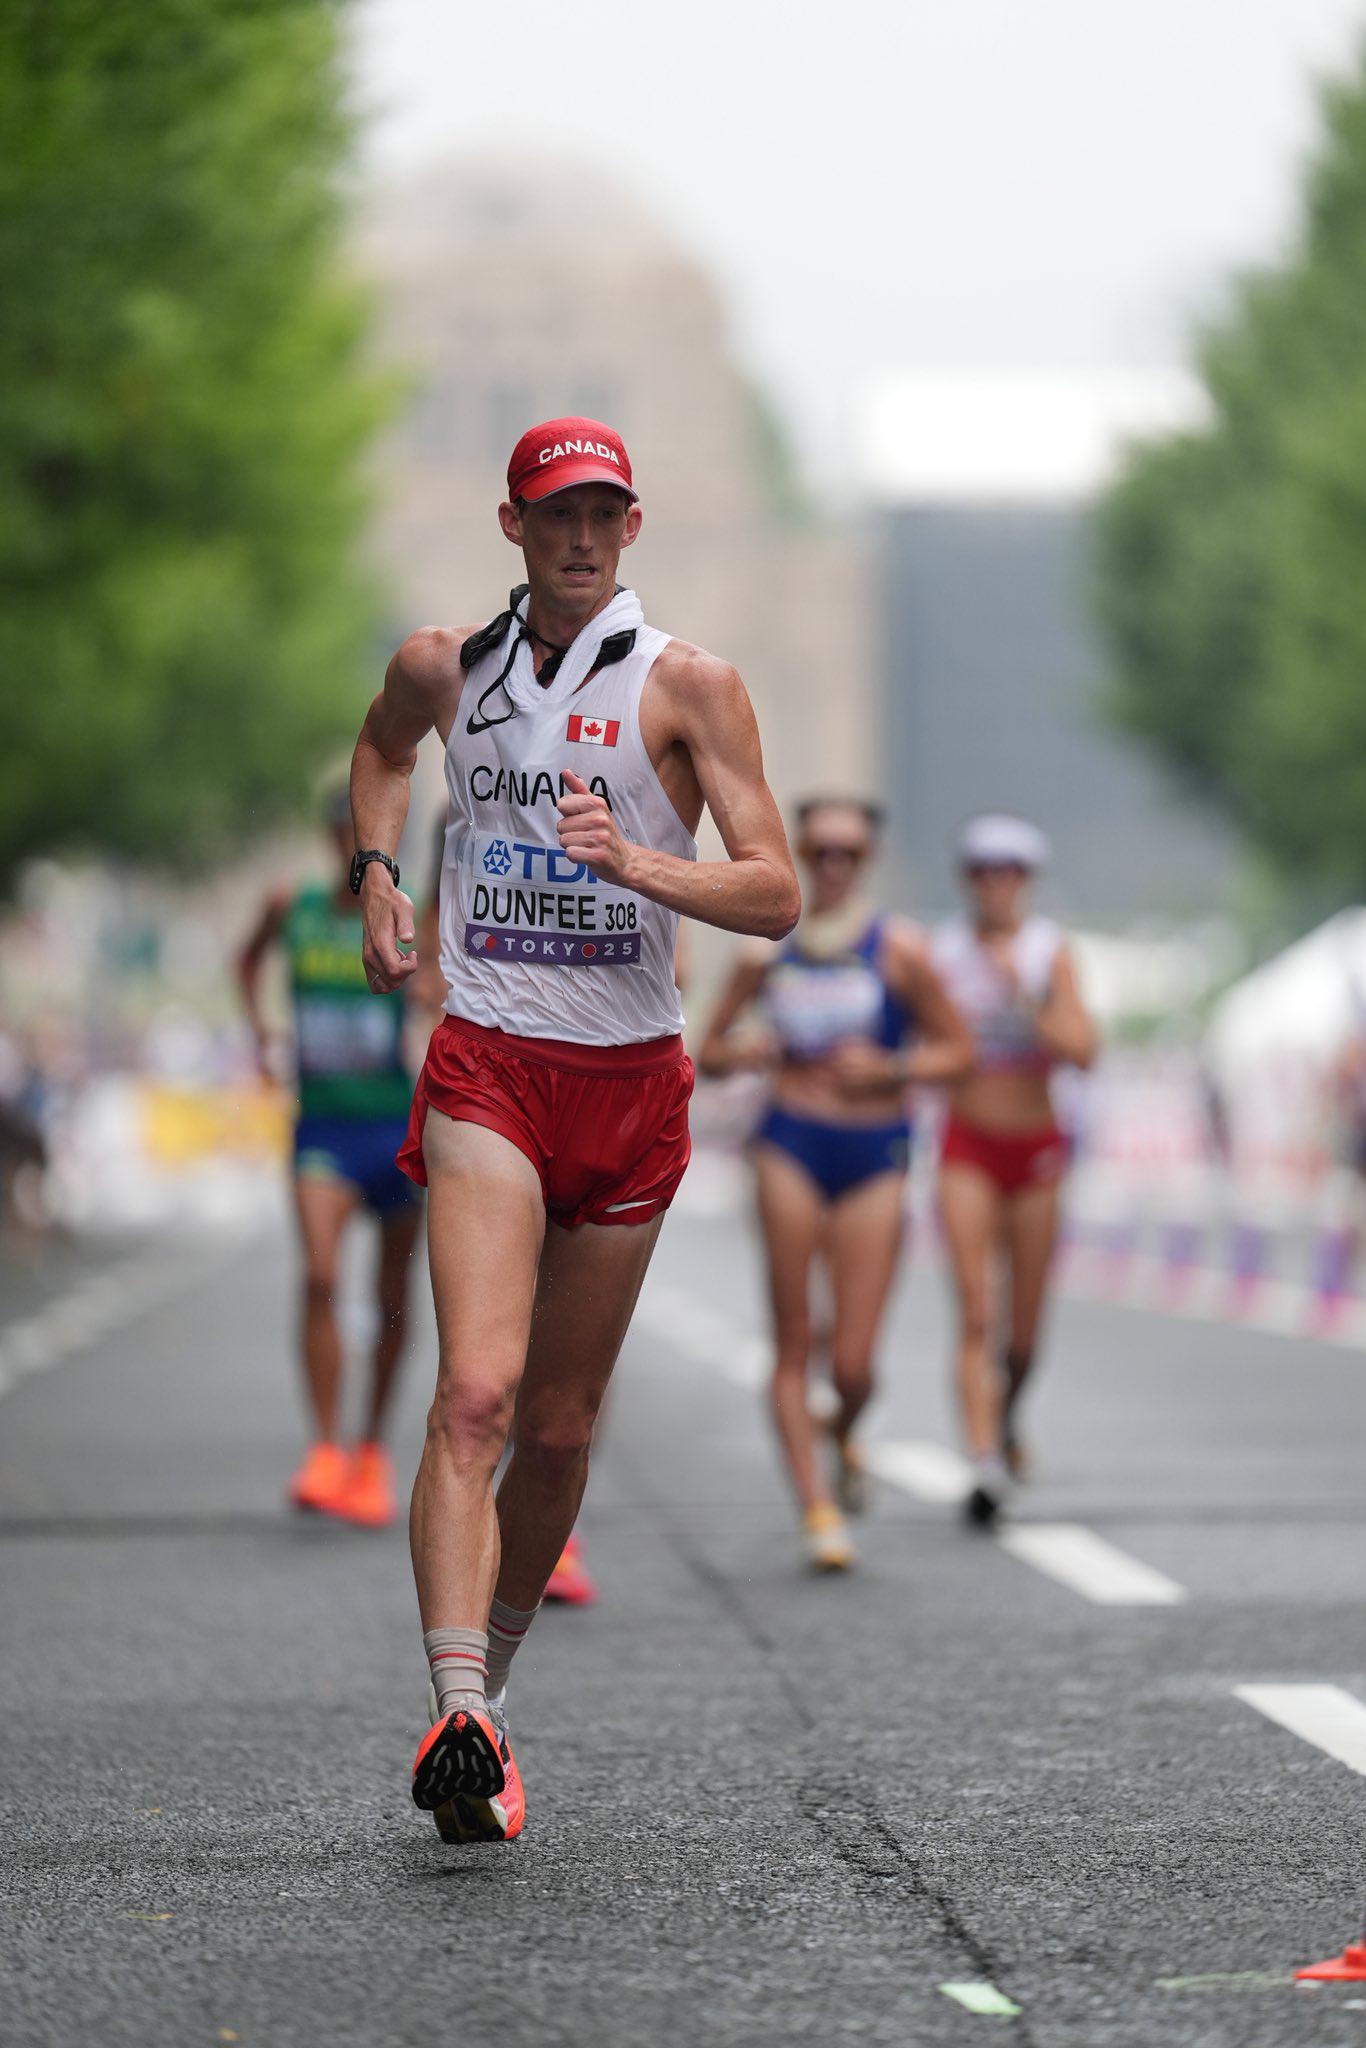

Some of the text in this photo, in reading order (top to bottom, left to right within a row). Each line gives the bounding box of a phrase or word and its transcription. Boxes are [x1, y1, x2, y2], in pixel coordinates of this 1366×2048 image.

[538, 439, 620, 466] CANADA
[512, 842, 598, 884] TD
[472, 884, 637, 932] DUNFEE 308
[603, 941, 633, 957] 25
